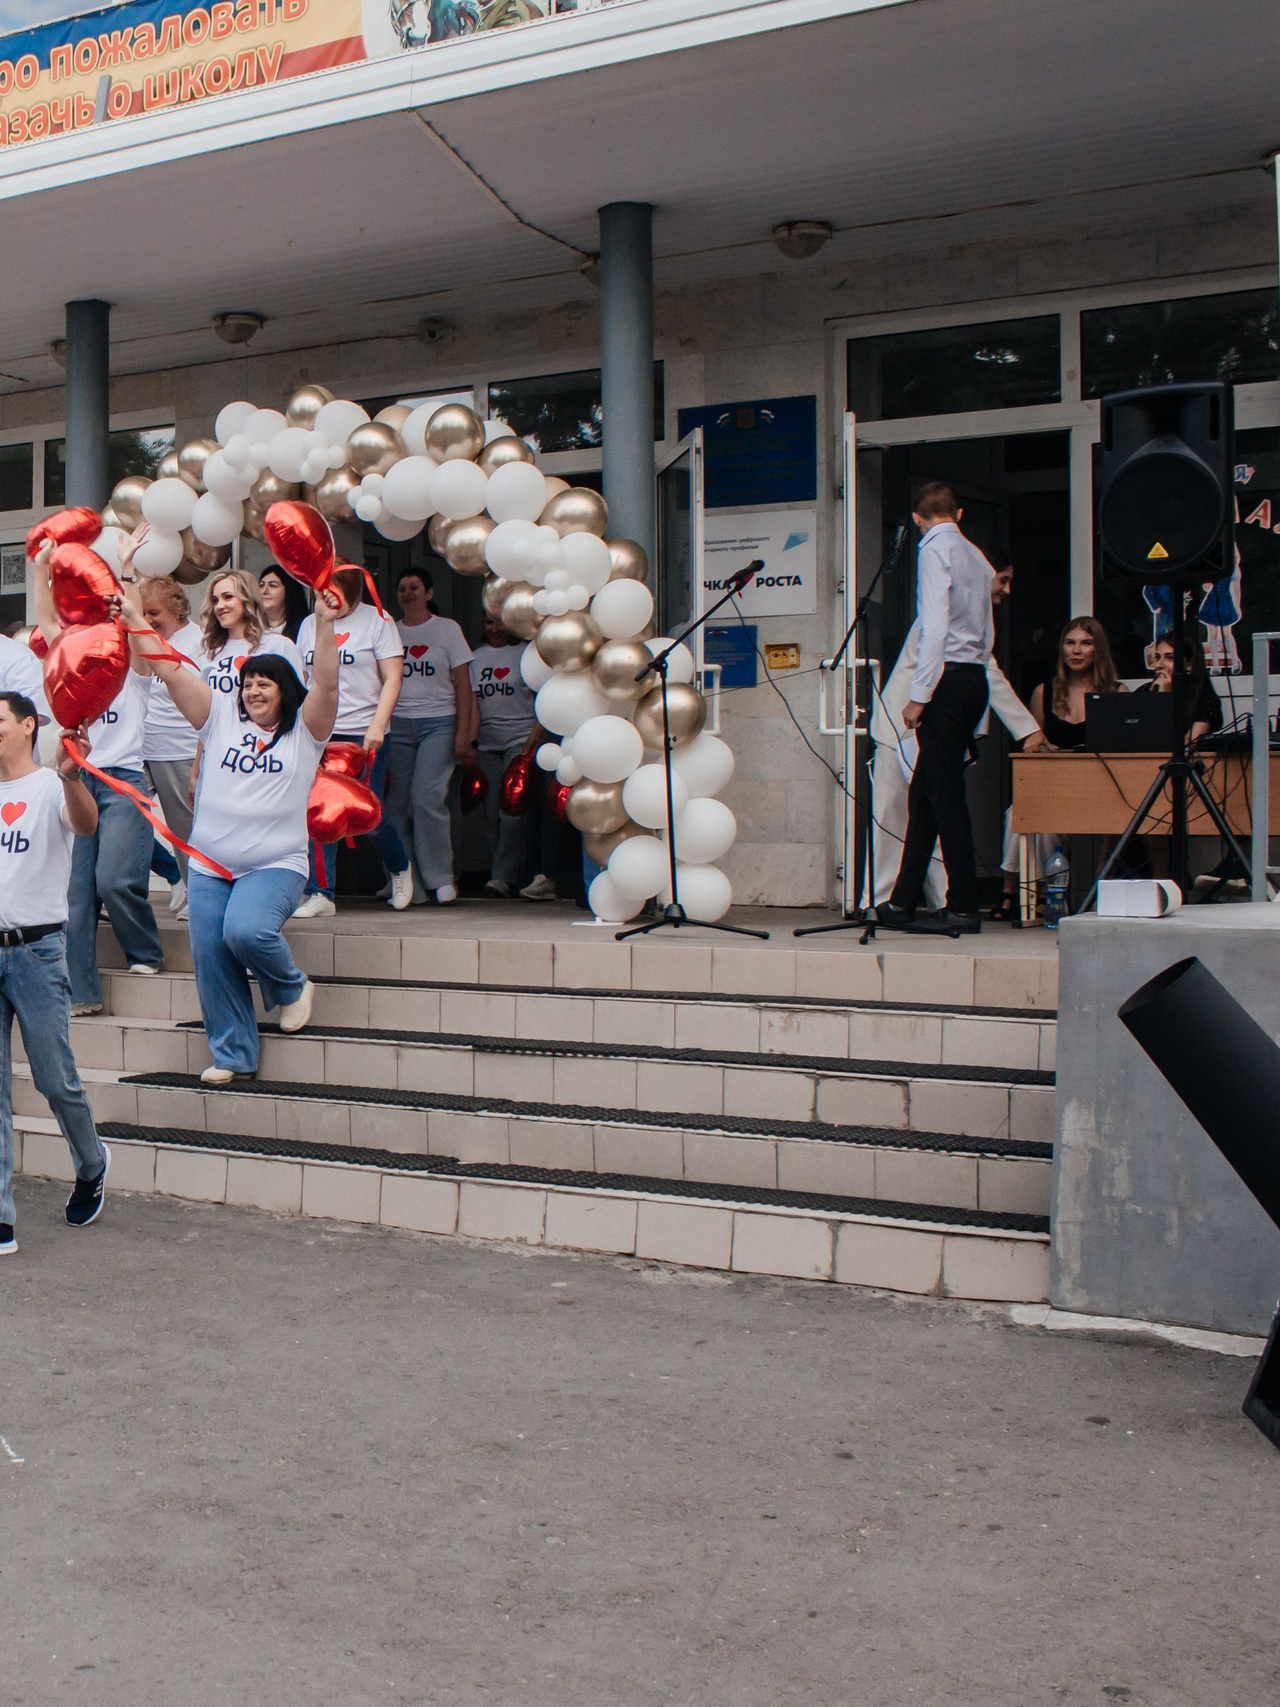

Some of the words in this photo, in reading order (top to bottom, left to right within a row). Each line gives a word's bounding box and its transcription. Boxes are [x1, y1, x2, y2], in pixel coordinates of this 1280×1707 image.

[49, 0, 308, 82] пожаловать
[143, 41, 285, 112] школу
[755, 575, 803, 588] РОСТА
[217, 656, 233, 674] Я
[403, 661, 436, 678] ОЧЬ
[480, 667, 494, 682] Я
[240, 732, 258, 753] Я
[220, 746, 284, 774] ДОЧЬ
